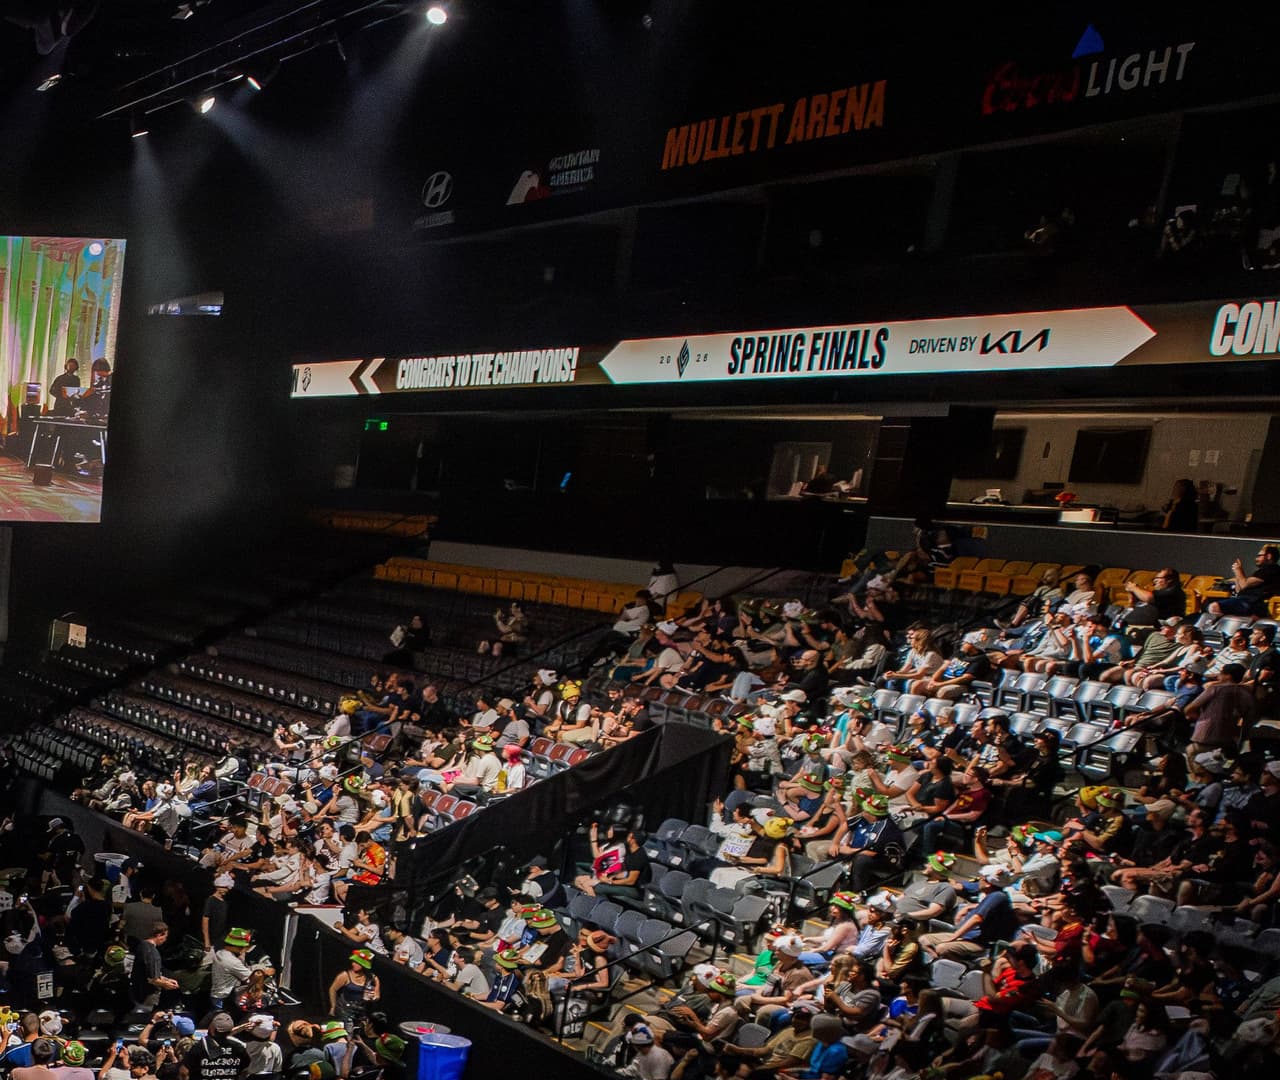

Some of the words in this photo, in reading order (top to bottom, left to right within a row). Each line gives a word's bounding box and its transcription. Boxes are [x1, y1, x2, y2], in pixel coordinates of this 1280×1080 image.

[1085, 41, 1196, 97] LIGHT
[659, 102, 786, 171] MULLETT
[784, 79, 888, 145] ARENA
[728, 332, 806, 375] SPRING
[807, 327, 890, 373] FINALS
[909, 337, 958, 355] DRIVEN
[959, 335, 978, 353] BY
[980, 328, 1051, 354] KIA
[1209, 301, 1280, 357] CON
[396, 357, 456, 390] CONGRATS
[454, 354, 474, 388] TO
[472, 352, 495, 387] THE
[493, 347, 580, 386] CHAMPIONS!
